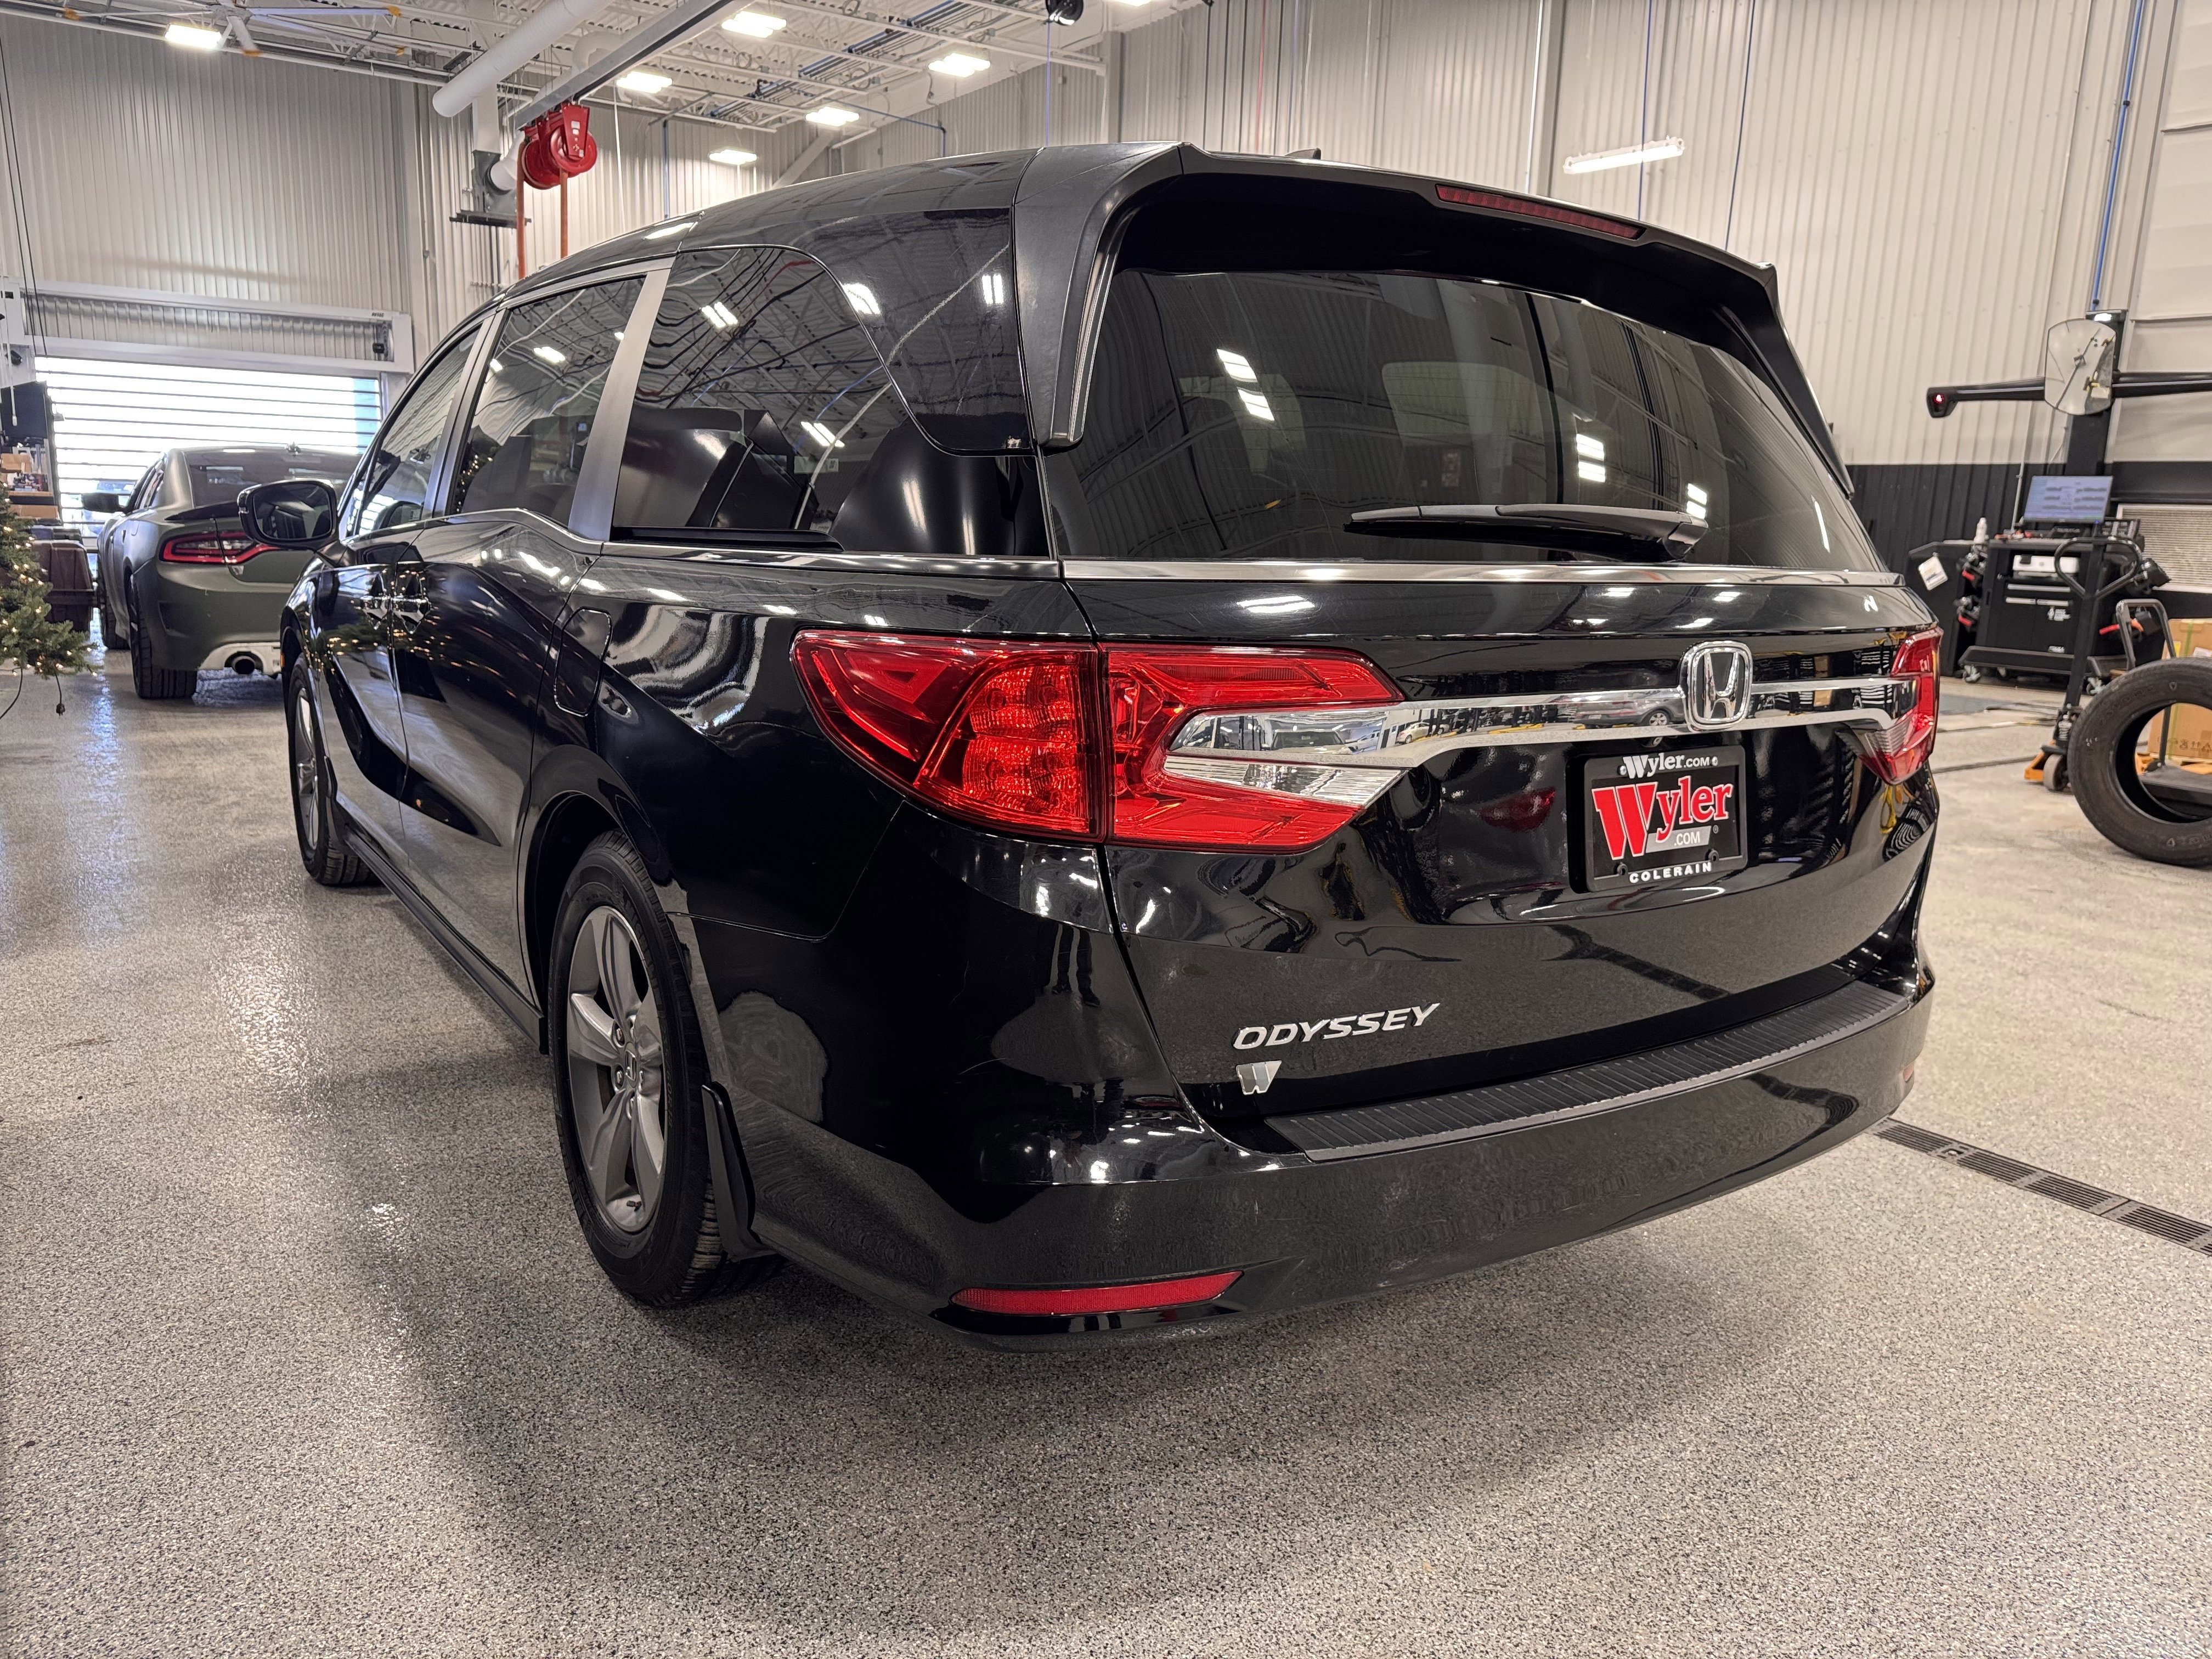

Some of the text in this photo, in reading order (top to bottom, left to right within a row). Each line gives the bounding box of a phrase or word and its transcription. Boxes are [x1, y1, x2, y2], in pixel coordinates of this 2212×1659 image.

[1592, 775, 1733, 860] Wyler
[1674, 831, 1700, 845] .COM
[1629, 862, 1712, 883] COLERAIN
[1233, 1002, 1441, 1049] ODYSSEY
